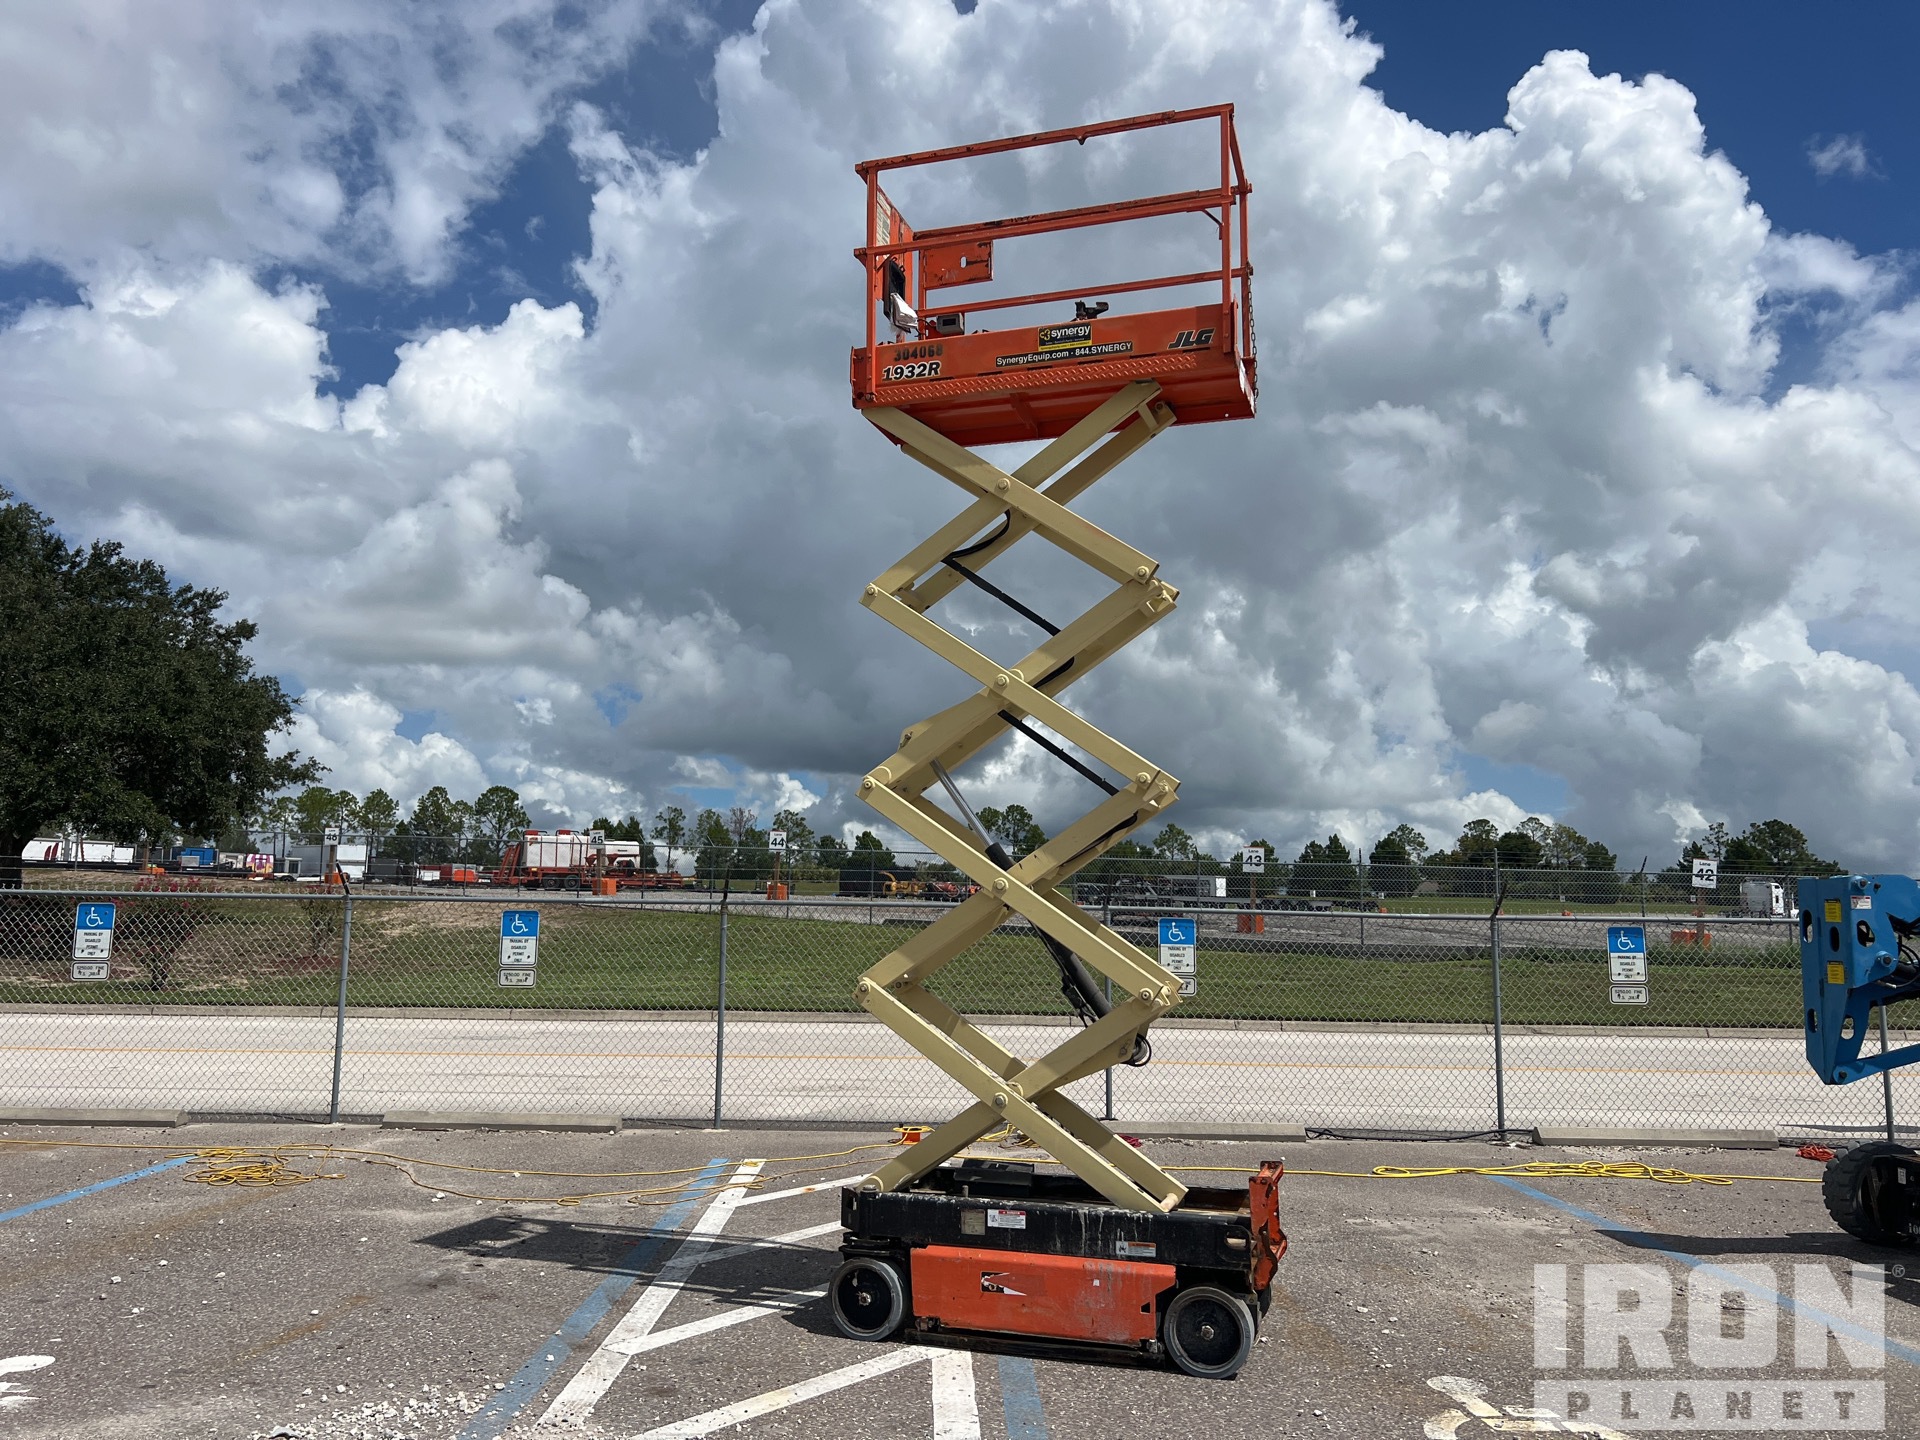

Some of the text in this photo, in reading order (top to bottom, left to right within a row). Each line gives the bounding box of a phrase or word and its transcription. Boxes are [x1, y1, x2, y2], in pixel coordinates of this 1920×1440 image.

[1051, 326, 1090, 338] synergy
[1167, 328, 1216, 350] JLG
[997, 350, 1068, 366] SynergyEquip.com
[1075, 342, 1132, 356] 844.SYNERGY
[882, 361, 941, 381] 1932R
[591, 836, 602, 844] 45
[771, 837, 784, 847] 44
[1244, 855, 1262, 866] 43
[1695, 868, 1714, 881] 42
